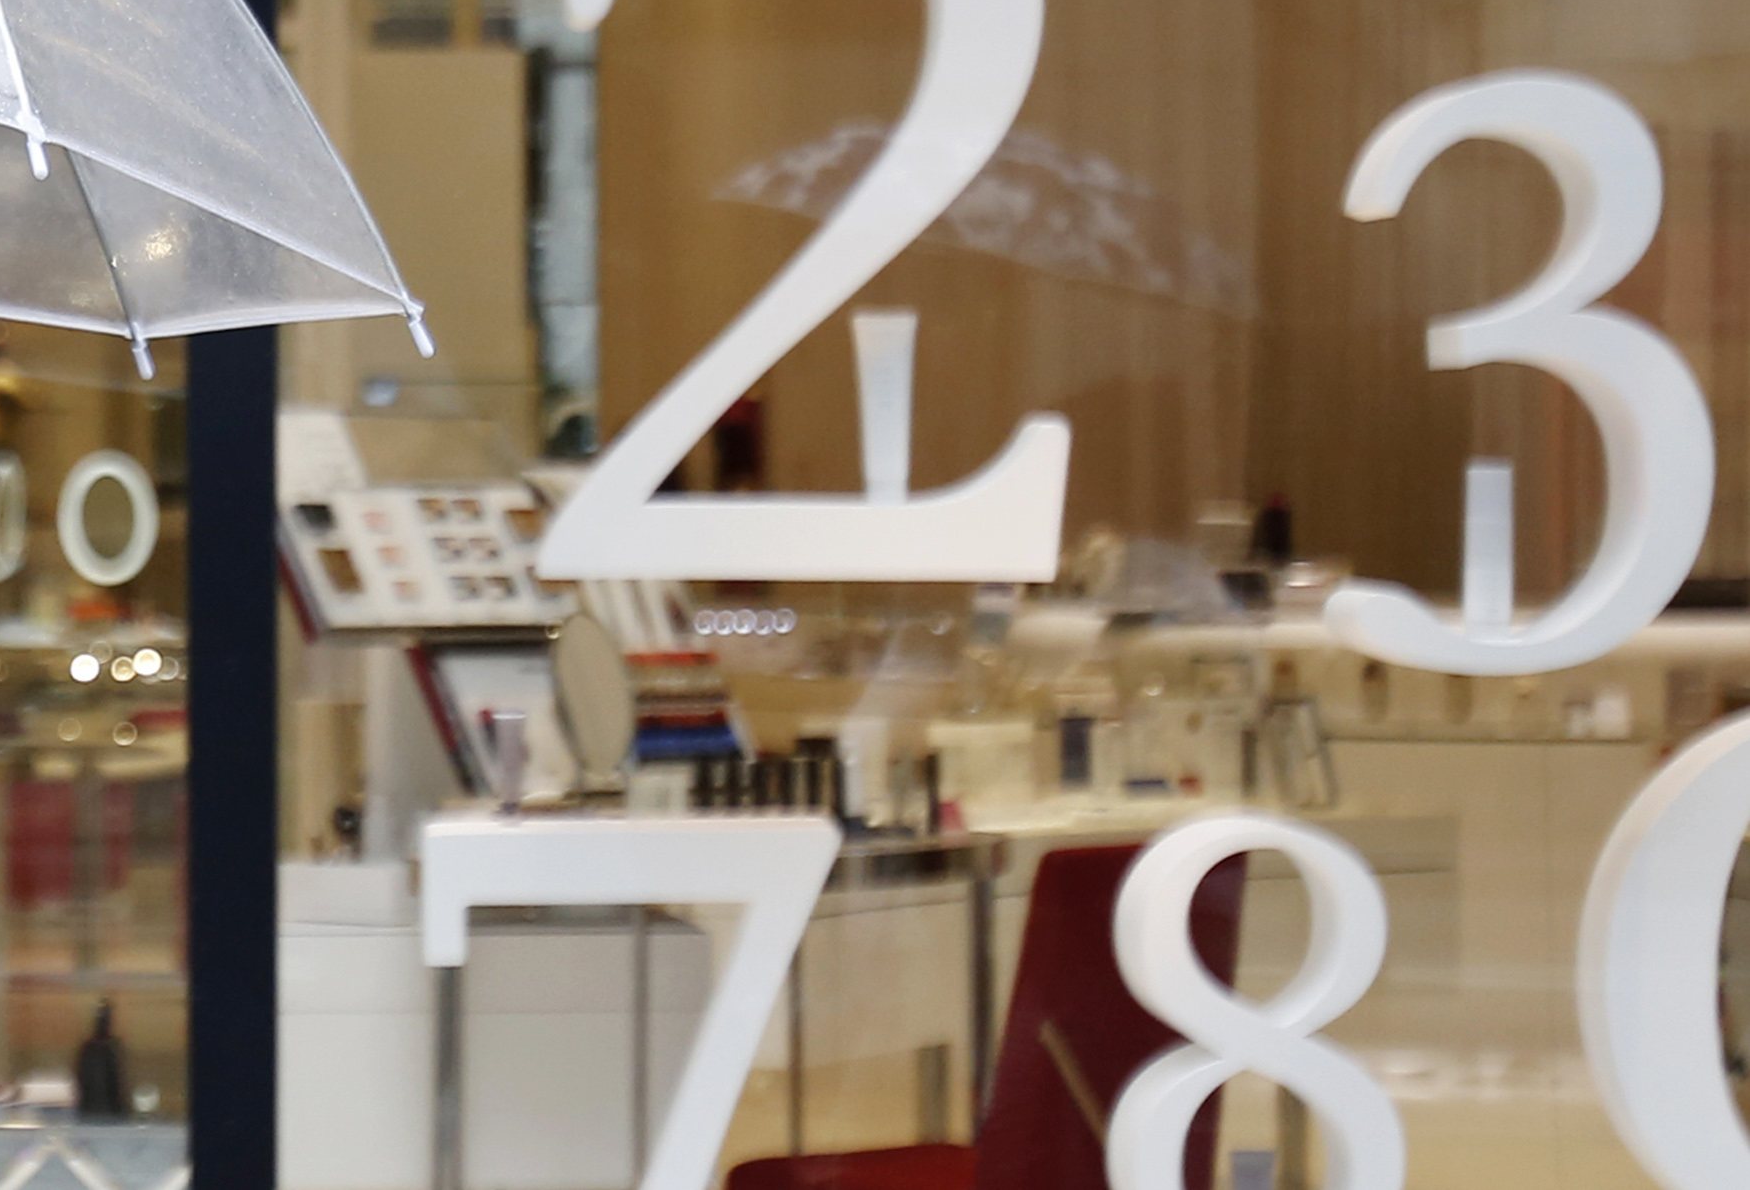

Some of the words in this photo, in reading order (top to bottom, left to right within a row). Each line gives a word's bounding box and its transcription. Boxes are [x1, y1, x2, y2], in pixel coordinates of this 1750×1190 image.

[1323, 67, 1716, 676] 3
[422, 812, 842, 1190] 7
[1105, 813, 1408, 1190] 8
